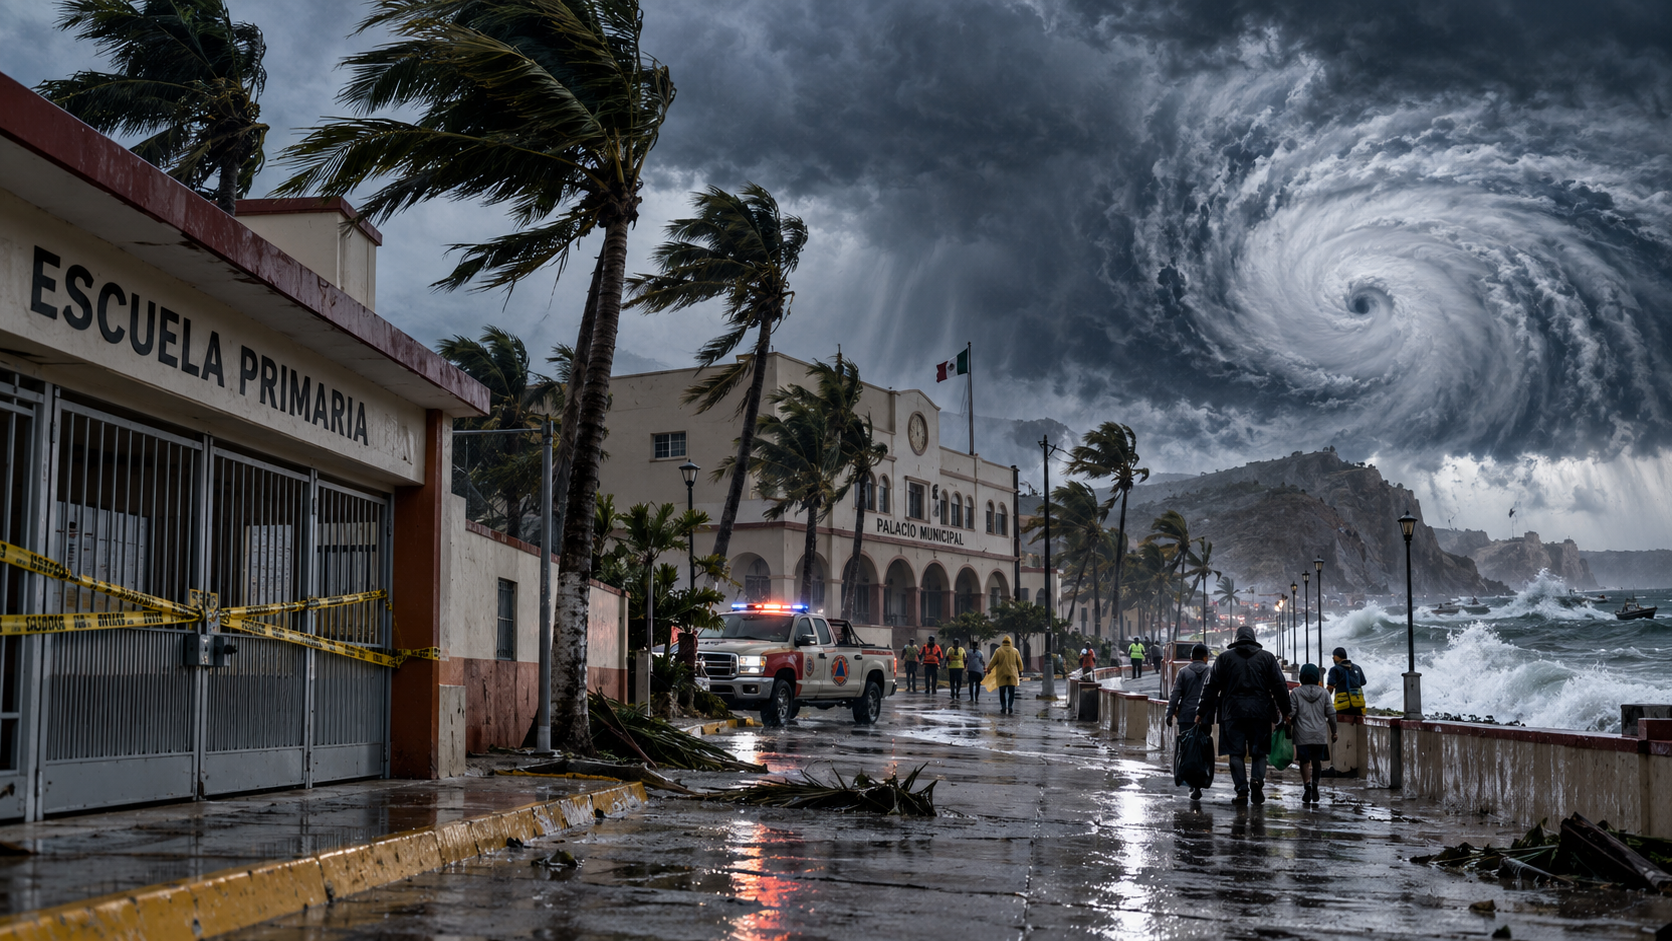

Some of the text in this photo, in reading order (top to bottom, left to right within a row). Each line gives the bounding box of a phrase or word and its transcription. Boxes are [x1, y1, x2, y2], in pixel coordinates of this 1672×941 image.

[31, 245, 369, 446] ESCUELA PRIMARIA
[877, 518, 964, 545] PALACIO MUNICIPAL
